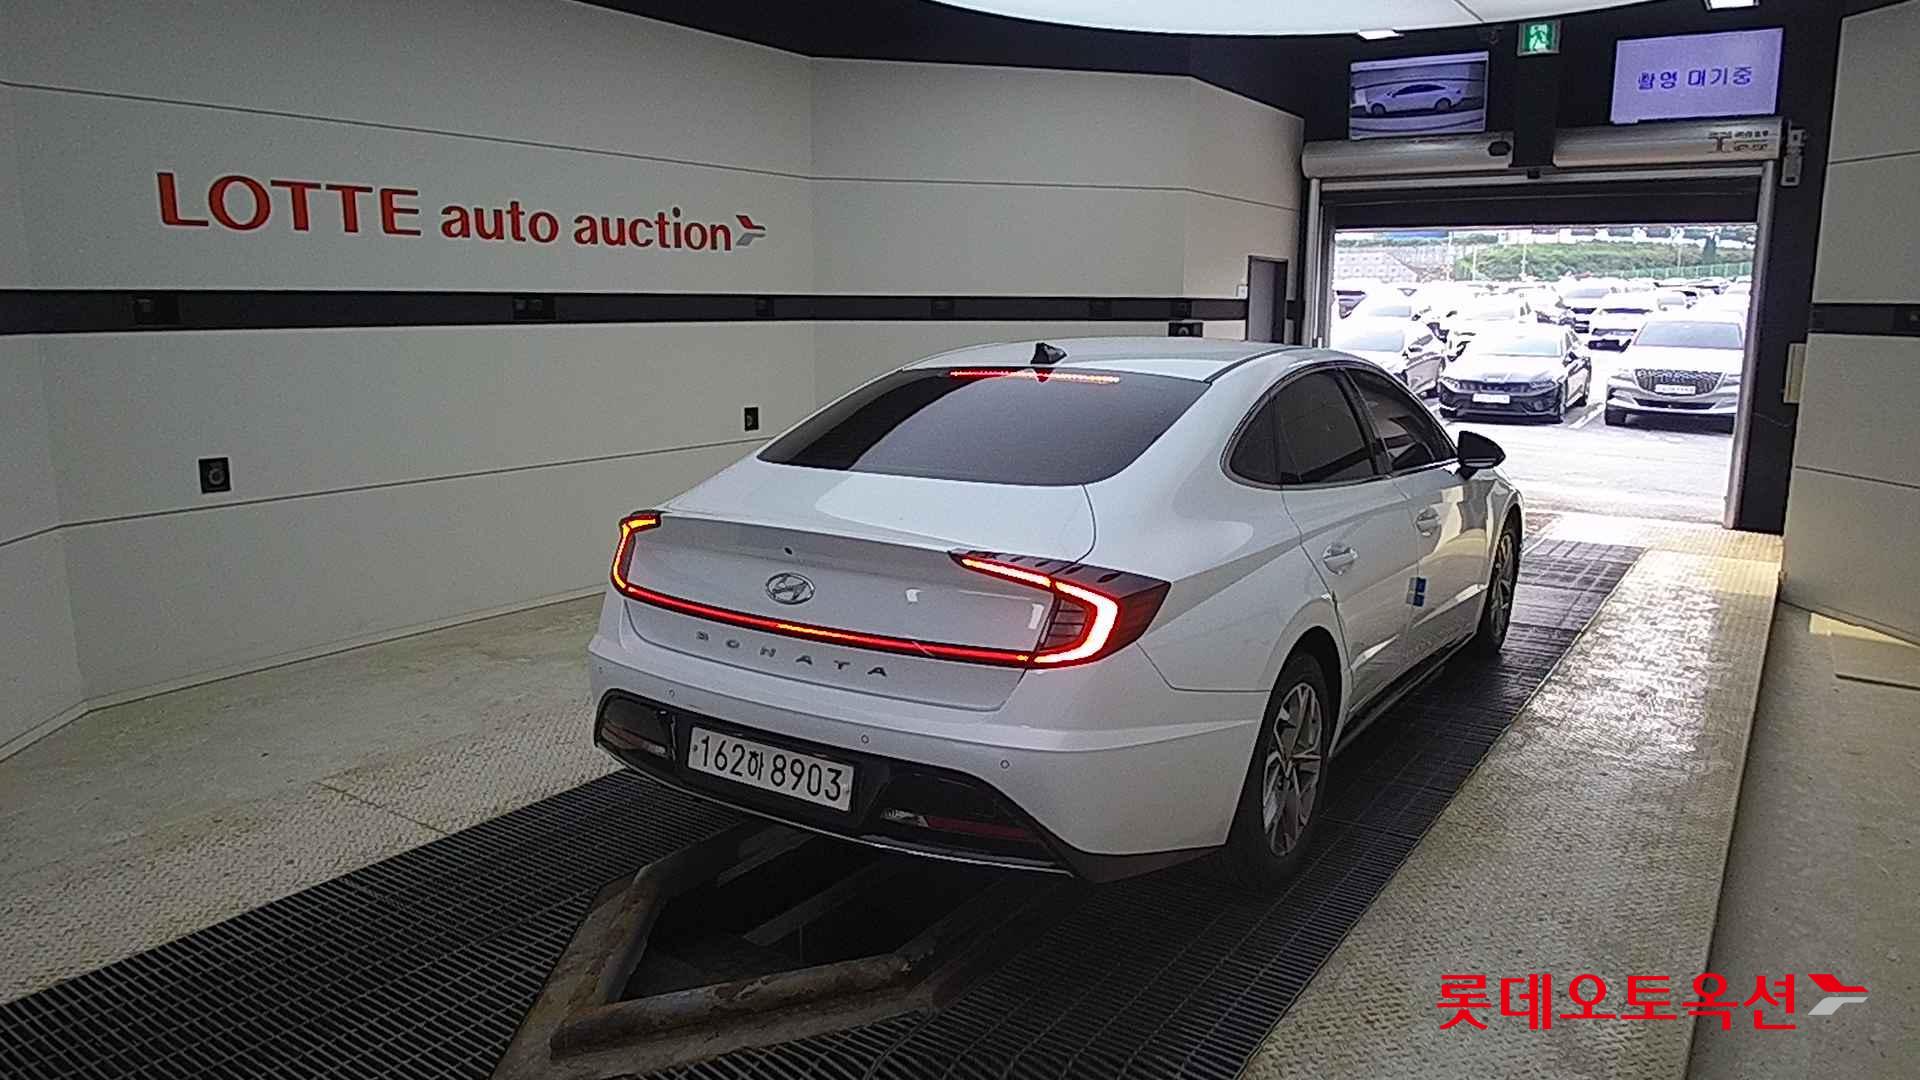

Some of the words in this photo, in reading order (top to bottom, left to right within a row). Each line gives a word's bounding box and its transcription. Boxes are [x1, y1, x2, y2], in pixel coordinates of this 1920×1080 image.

[1687, 66, 1752, 86] 대기중
[156, 171, 421, 237] LOTTE
[441, 201, 560, 244] auto
[573, 206, 733, 252] auction
[697, 631, 887, 677] SONATA
